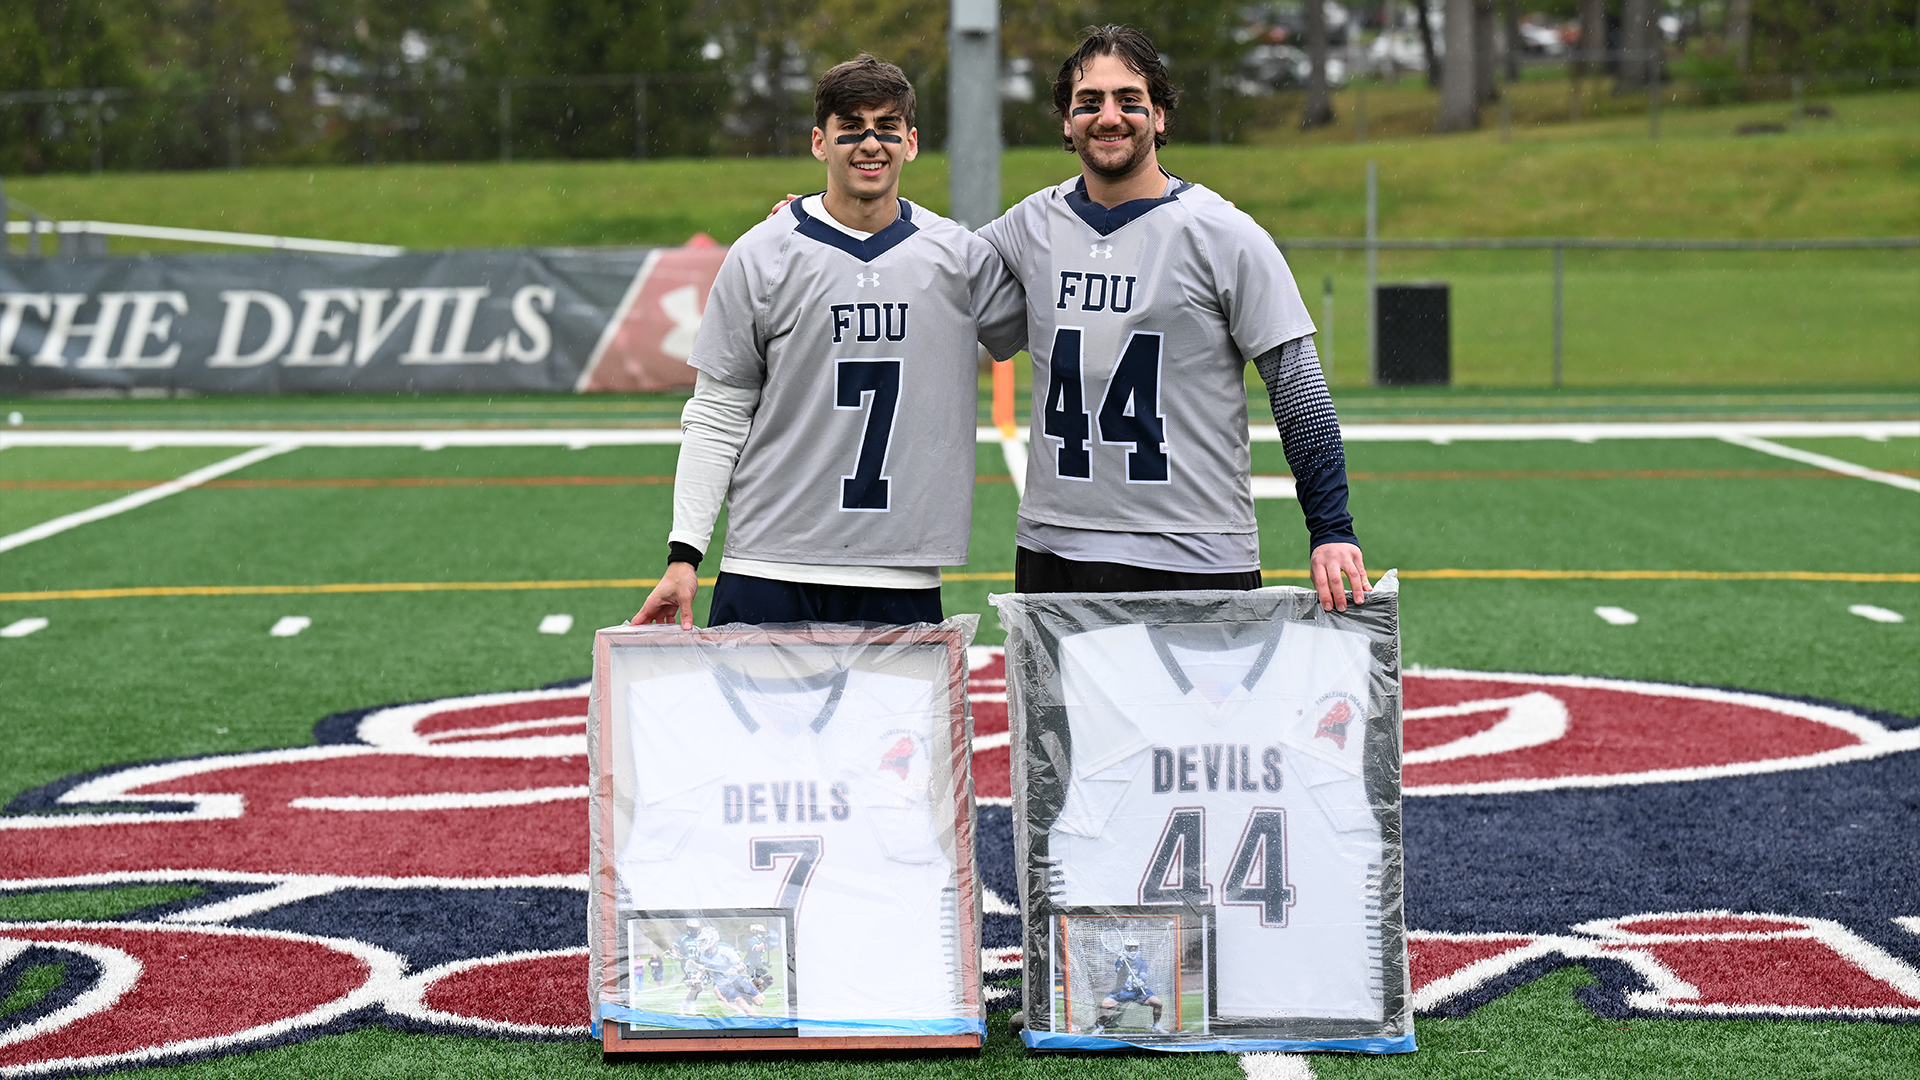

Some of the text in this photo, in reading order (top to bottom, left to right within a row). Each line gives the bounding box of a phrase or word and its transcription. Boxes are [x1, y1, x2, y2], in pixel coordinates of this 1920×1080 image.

[0, 283, 556, 369] THE DEVILS
[830, 302, 909, 343] FDU
[1056, 270, 1136, 314] FDU
[833, 358, 904, 513] 7
[1043, 325, 1171, 485] 44
[722, 780, 852, 824] DEVILS
[1151, 743, 1284, 795] DEVILS
[749, 835, 824, 945] 7
[1137, 806, 1297, 929] 44
